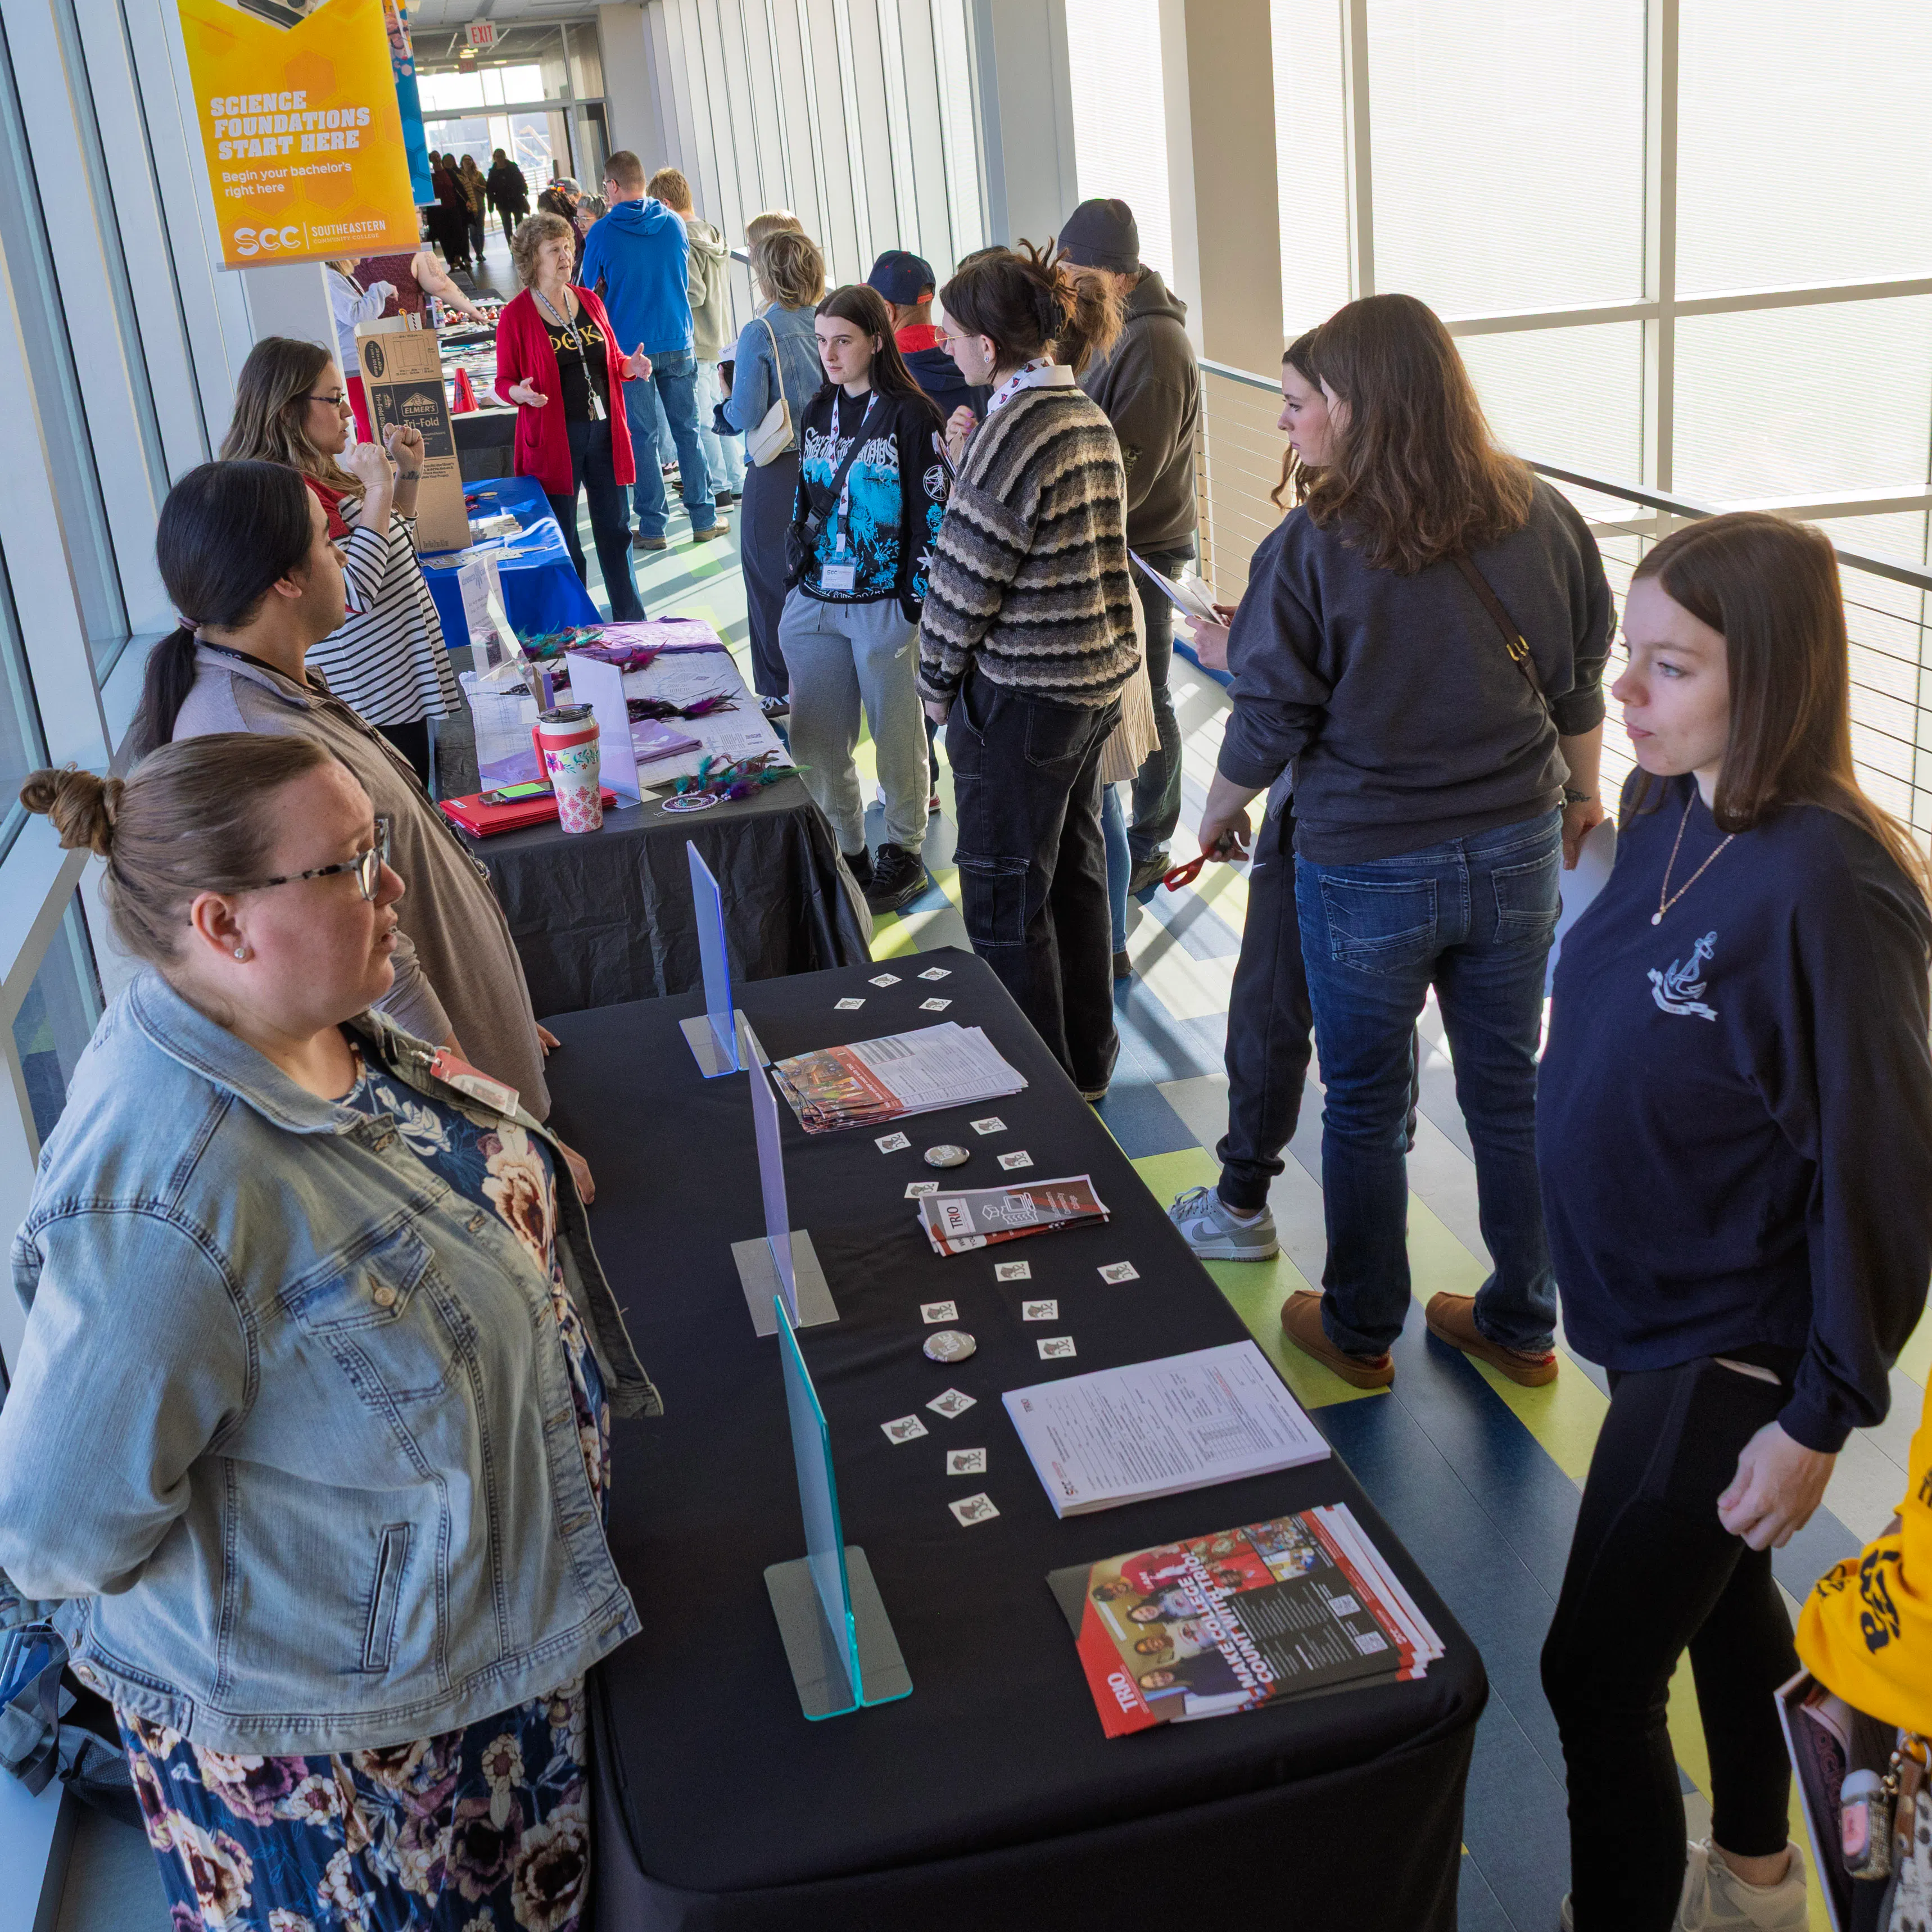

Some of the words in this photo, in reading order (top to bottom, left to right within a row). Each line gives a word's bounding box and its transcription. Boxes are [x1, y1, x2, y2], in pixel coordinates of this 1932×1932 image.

[470, 25, 493, 44] EXIT
[210, 91, 307, 116] SCIENCE
[214, 107, 370, 138] FOUNDATIONS
[218, 135, 293, 160] START
[300, 130, 360, 153] HERE
[222, 168, 257, 183] Begin
[260, 169, 288, 182] your
[290, 162, 352, 177] bachelor's
[224, 184, 257, 198] right
[257, 183, 286, 194] here
[234, 225, 301, 256] SCC
[311, 220, 386, 237] SOUTHEASTERN
[313, 234, 351, 244] COMMUNITY
[375, 393, 385, 415] Tri-Fold
[404, 405, 435, 414] ELMER'S
[404, 417, 440, 428] Tri-Fold
[947, 1206, 963, 1229] TRIO
[1178, 1576, 1227, 1641] COLLEGE
[1209, 1588, 1239, 1630] WITH
[1218, 1640, 1257, 1689] MAKE
[1230, 1631, 1274, 1683] COUNT
[1107, 1672, 1138, 1714] TRIO
